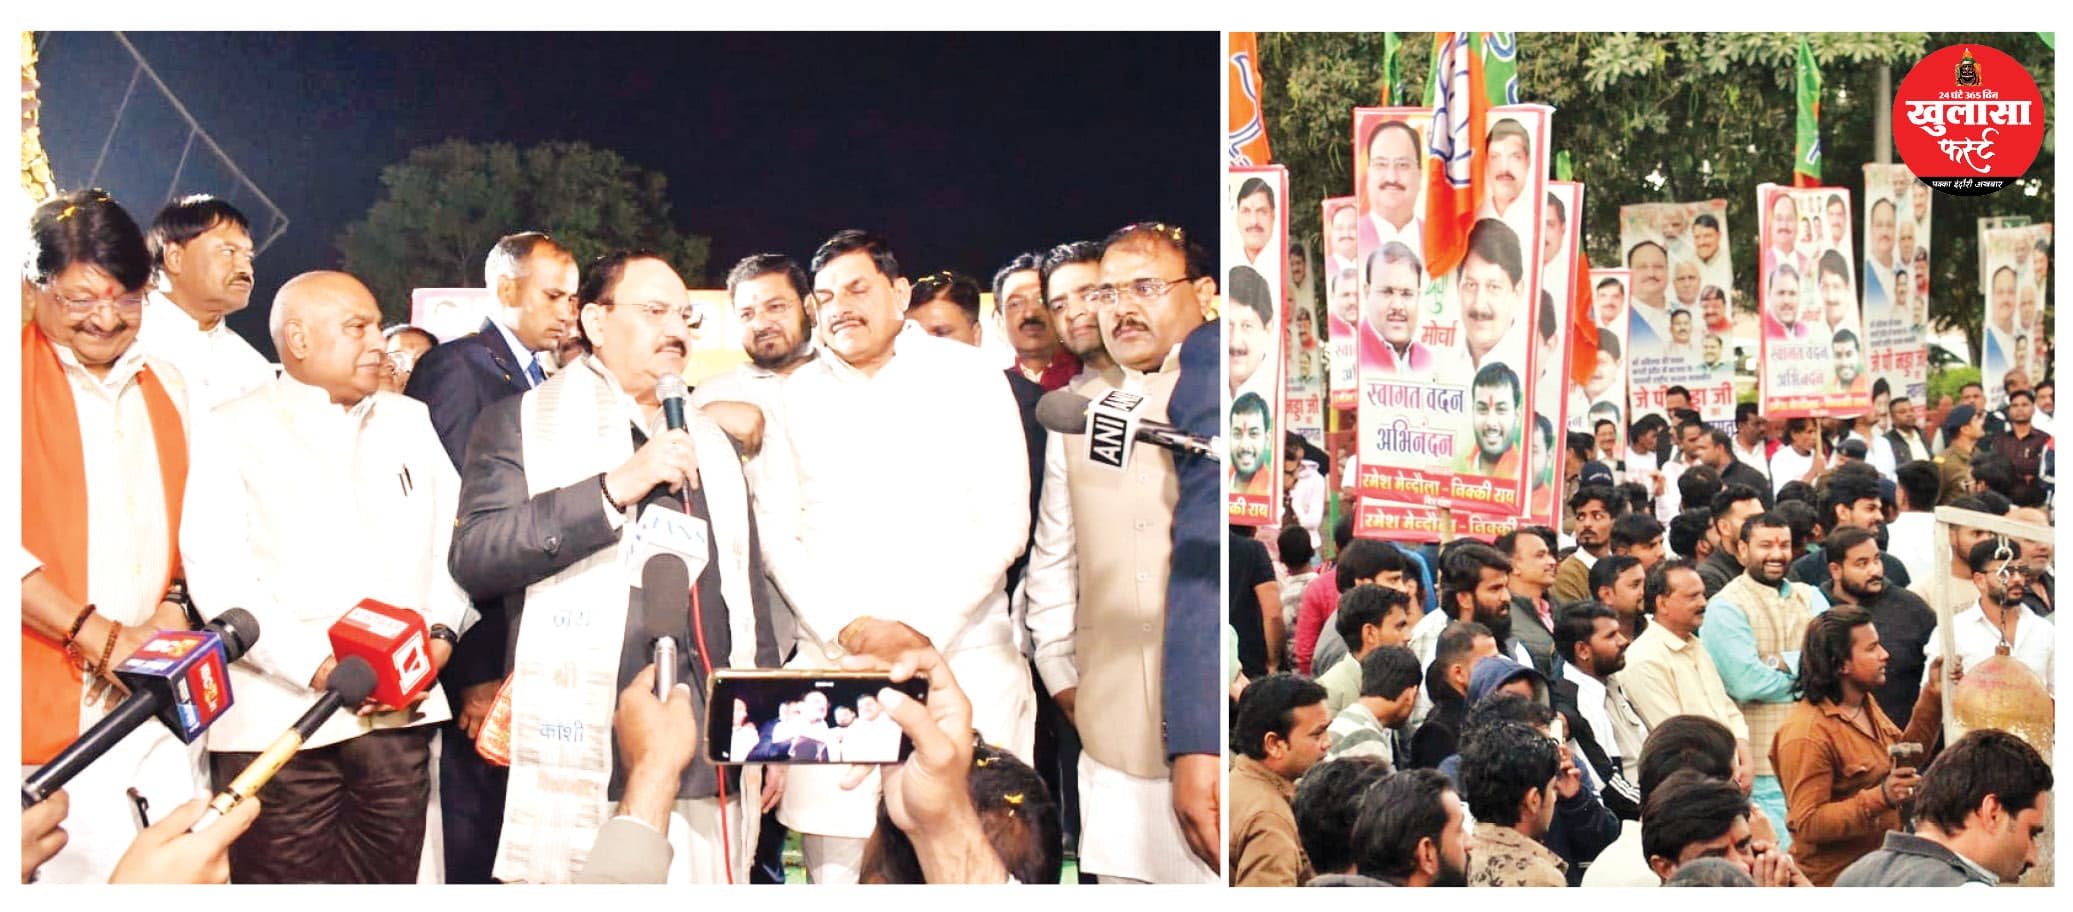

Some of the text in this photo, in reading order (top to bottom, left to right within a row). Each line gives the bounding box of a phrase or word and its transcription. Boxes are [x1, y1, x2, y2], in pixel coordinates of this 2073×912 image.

[1421, 320, 1458, 347] मोर्चा
[1367, 383, 1421, 409] स्वागत
[1425, 377, 1465, 413] वंदन
[1632, 384, 1649, 409] जे
[1710, 379, 1733, 405] जी
[1093, 415, 1125, 465] ANI
[1376, 418, 1456, 458] अभिनंदन
[1362, 466, 1393, 490] रमेश
[1494, 486, 1516, 505] राय
[1247, 502, 1270, 519] राय
[1364, 507, 1400, 529] रमेश
